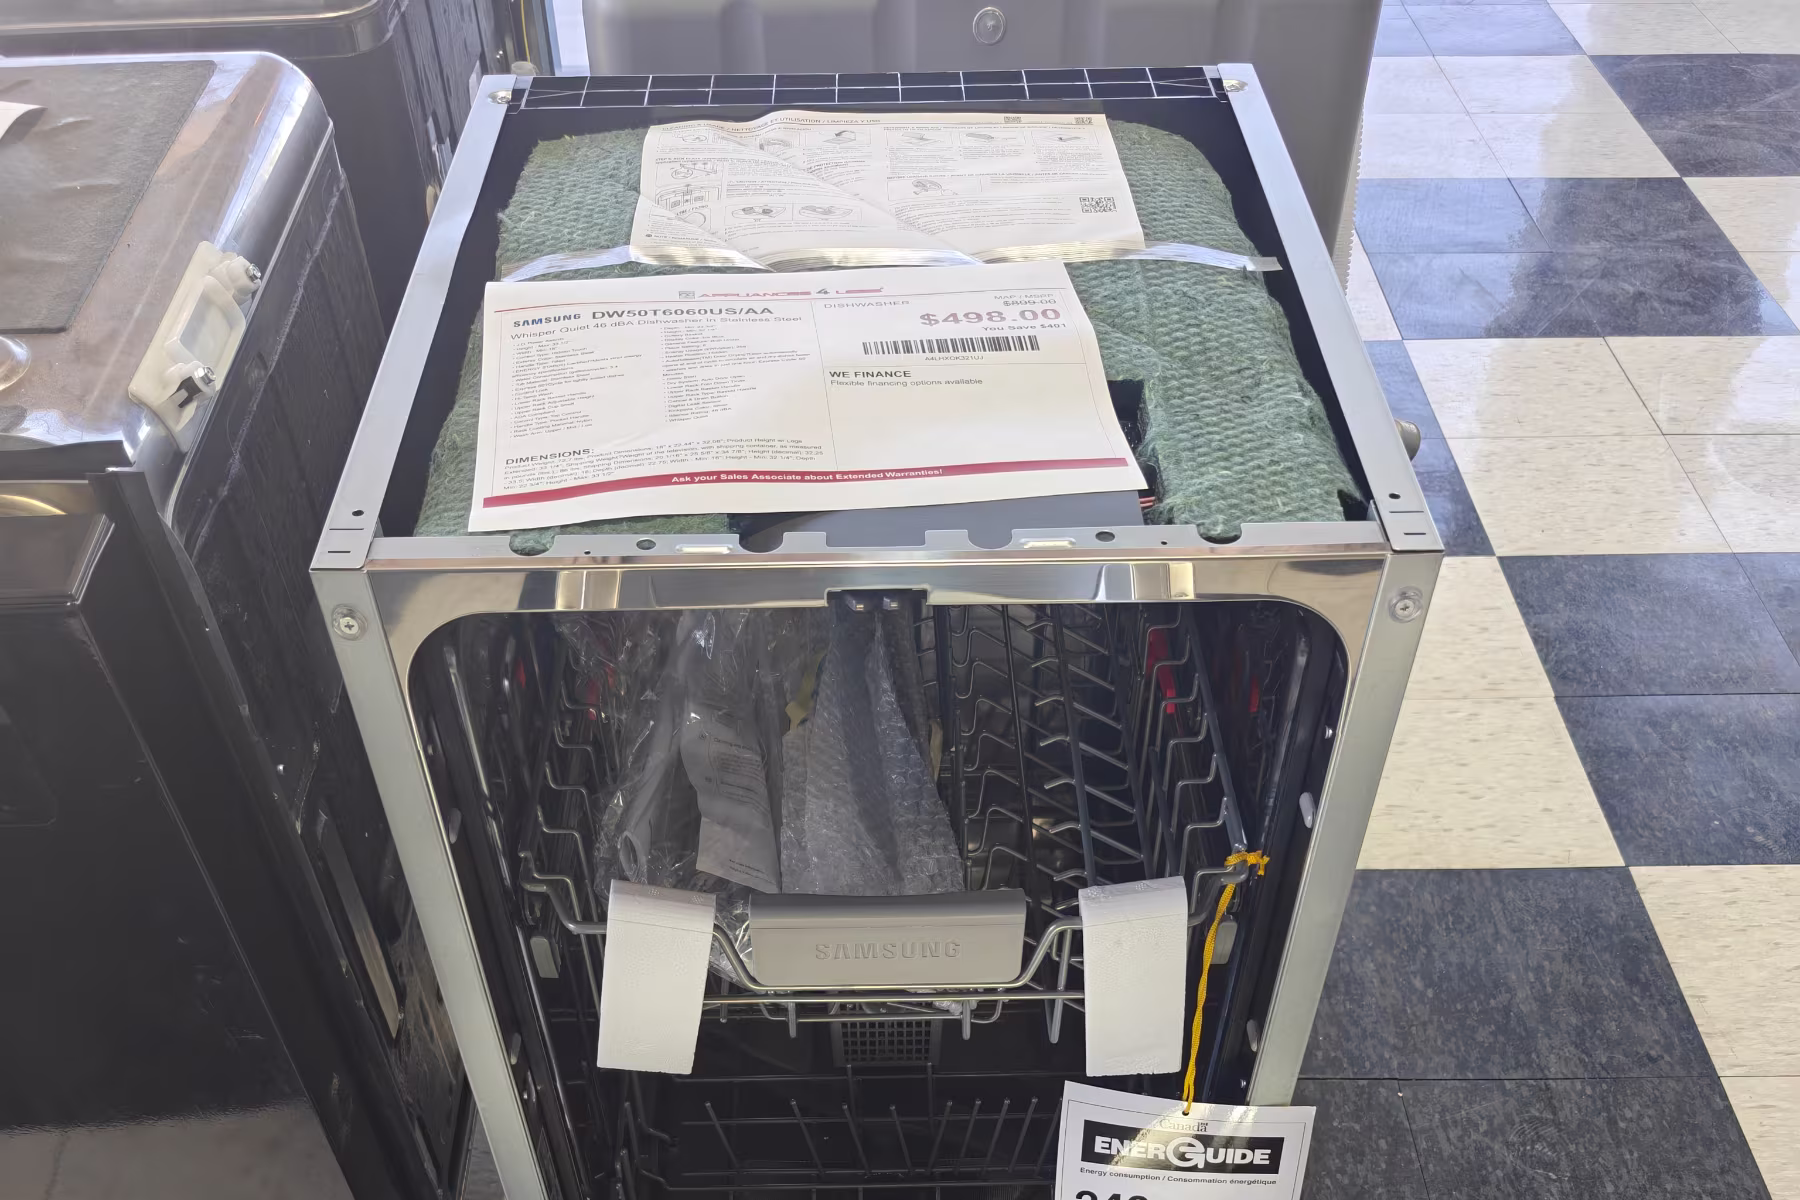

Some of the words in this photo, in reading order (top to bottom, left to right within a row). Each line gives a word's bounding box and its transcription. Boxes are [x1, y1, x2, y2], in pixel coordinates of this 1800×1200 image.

[816, 288, 831, 296] 4
[513, 313, 581, 328] SAMSUNG
[592, 307, 774, 320] DW50T6060US/AA
[919, 308, 1061, 327] $498.00
[510, 329, 556, 341] Whisper
[559, 324, 590, 334] Quiet
[610, 319, 634, 327] dBA
[637, 317, 703, 326] Dishwasher
[854, 370, 912, 378] FINANCE
[867, 379, 908, 388] financing
[910, 378, 942, 386] options
[944, 377, 983, 385] available
[506, 448, 595, 466] DIMENSIONS:
[694, 474, 717, 482] your
[835, 472, 884, 480] Extended
[885, 468, 943, 478] Warranties!
[815, 940, 962, 961] SAMSUNG
[1159, 1118, 1209, 1133] Canada
[1094, 1136, 1272, 1169] ENERGUIDE
[1080, 1167, 1108, 1177] Energy
[1109, 1171, 1161, 1181] consumption
[1167, 1175, 1228, 1184] Consommation
[1229, 1177, 1277, 1186] énergétique
